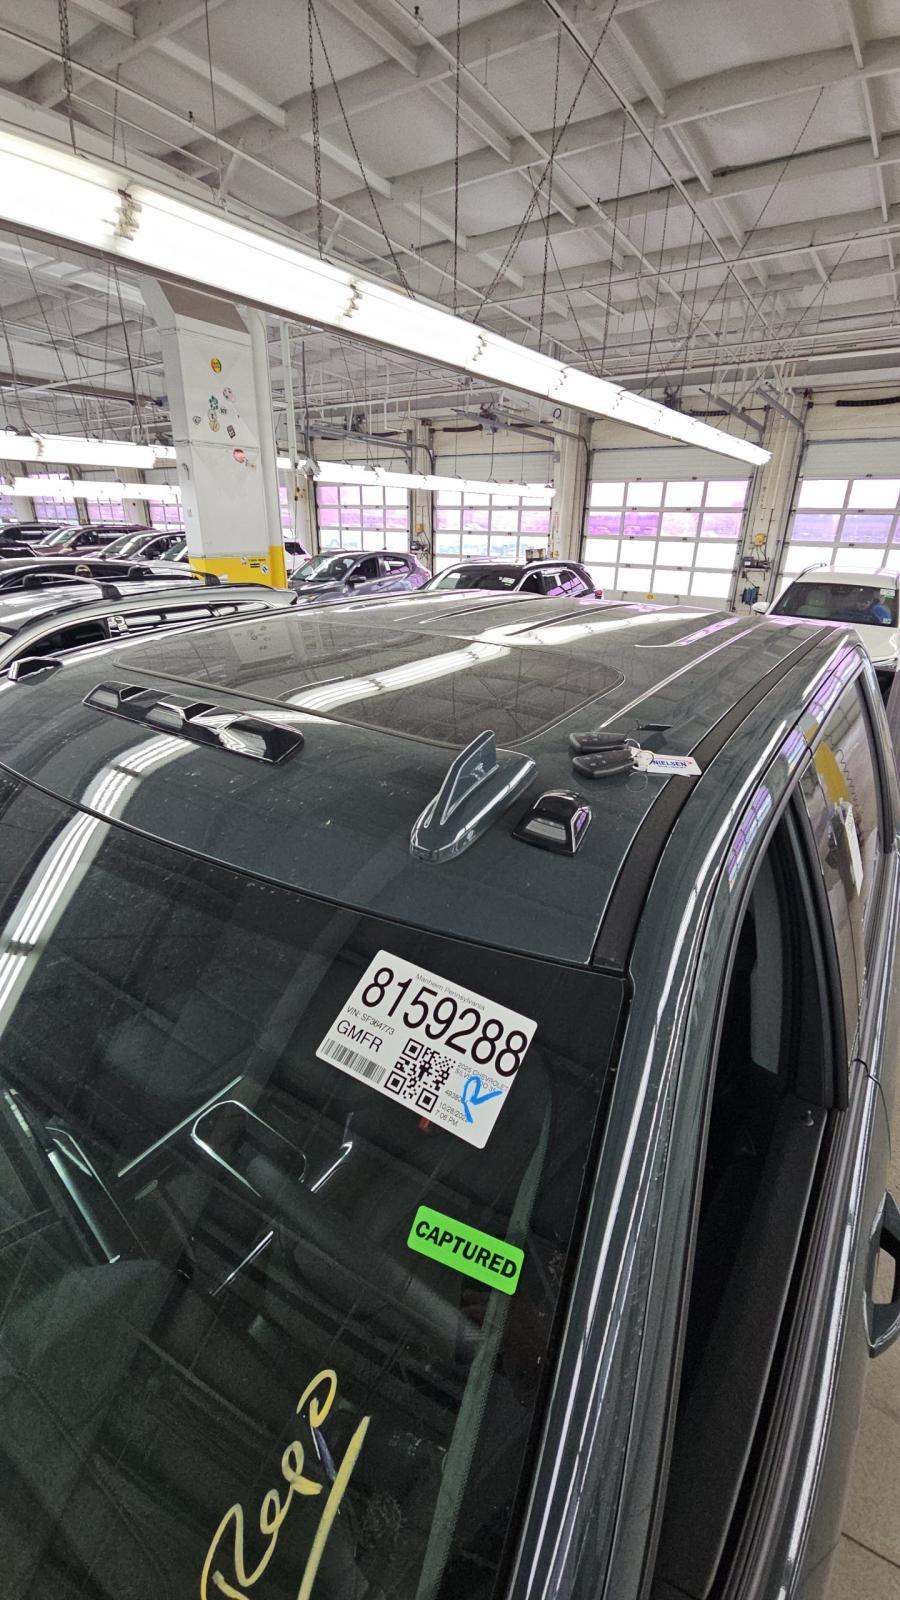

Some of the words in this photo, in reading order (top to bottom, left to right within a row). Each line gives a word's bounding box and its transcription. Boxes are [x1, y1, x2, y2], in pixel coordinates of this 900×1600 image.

[415, 974, 445, 991] Manheim
[445, 987, 486, 1010] Pennsylvania
[336, 1019, 384, 1051] GMFR
[360, 1013, 395, 1035] SF364773
[361, 967, 528, 1078] 8159288
[448, 1117, 459, 1127] PM
[416, 1221, 517, 1278] CAPTURED
